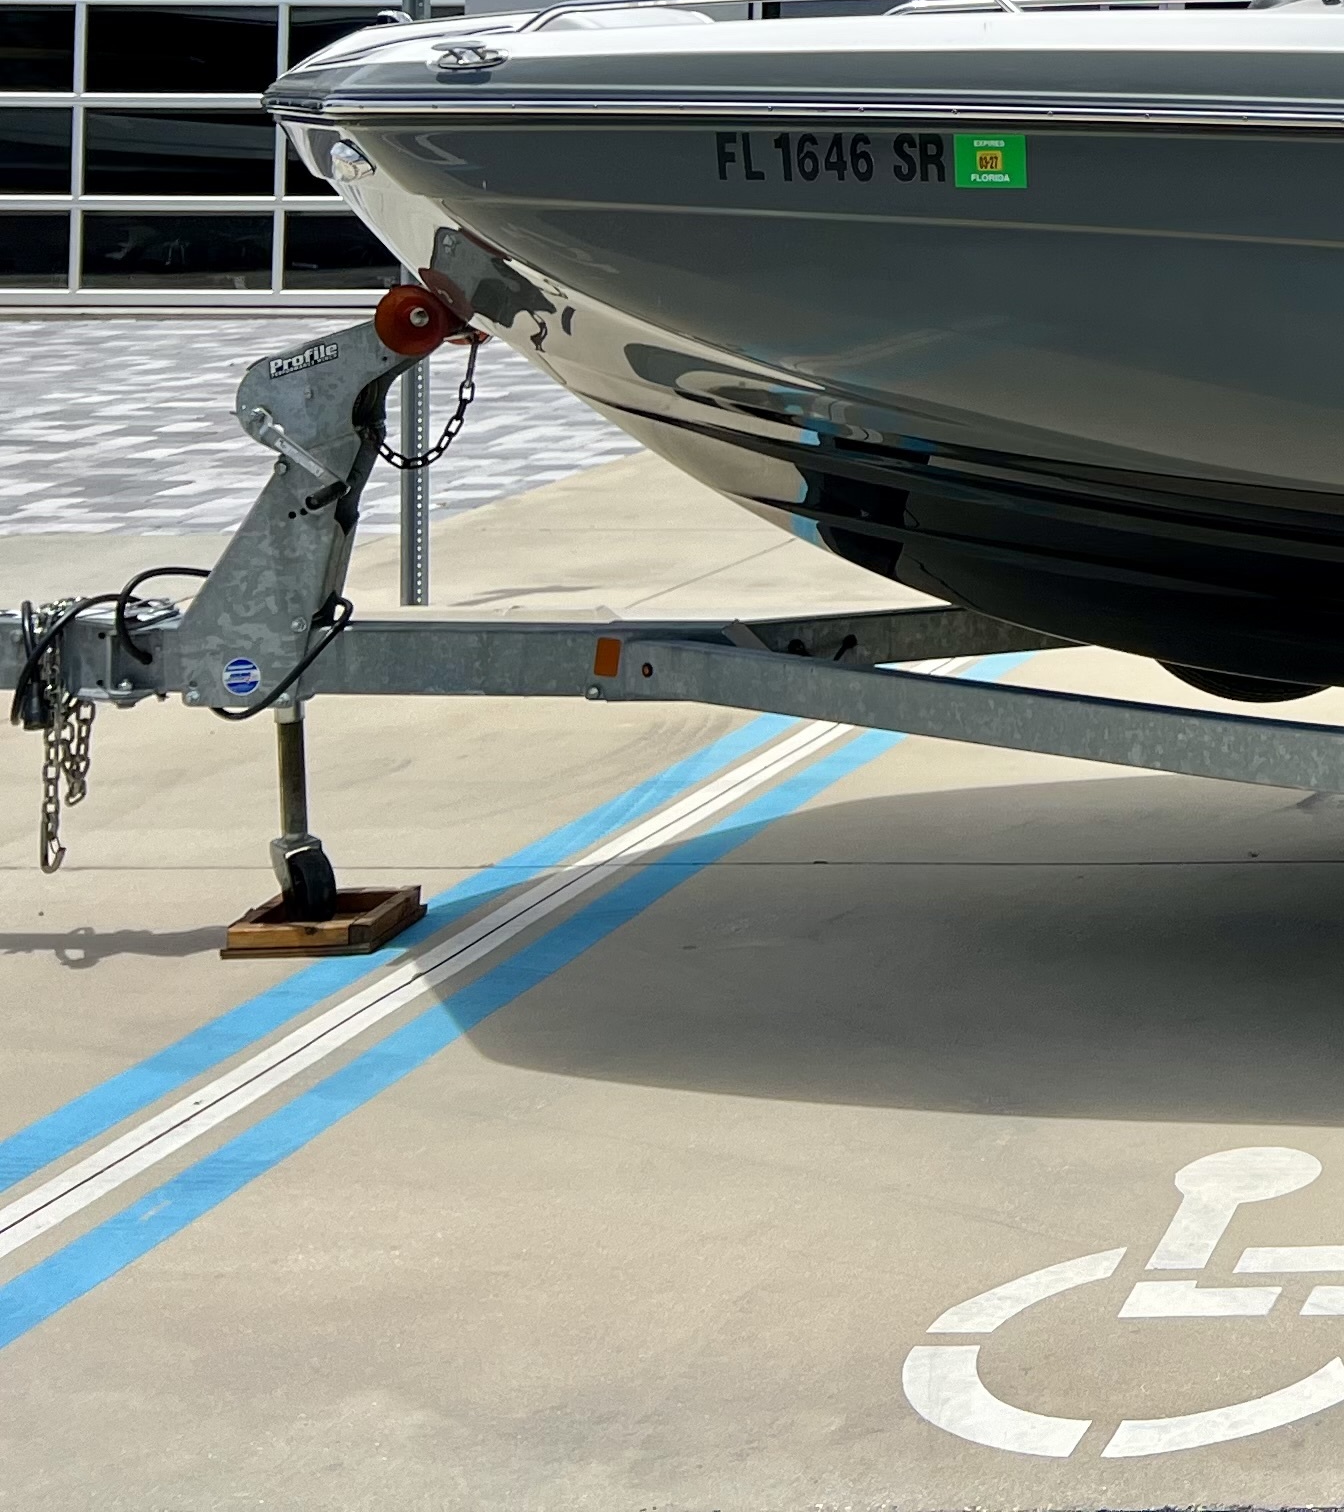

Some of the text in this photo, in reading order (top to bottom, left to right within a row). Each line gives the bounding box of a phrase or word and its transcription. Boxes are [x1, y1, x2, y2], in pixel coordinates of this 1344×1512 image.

[715, 131, 947, 183] FL 1646 SR
[970, 173, 1010, 182] FLORIDA
[269, 343, 338, 374] Profile
